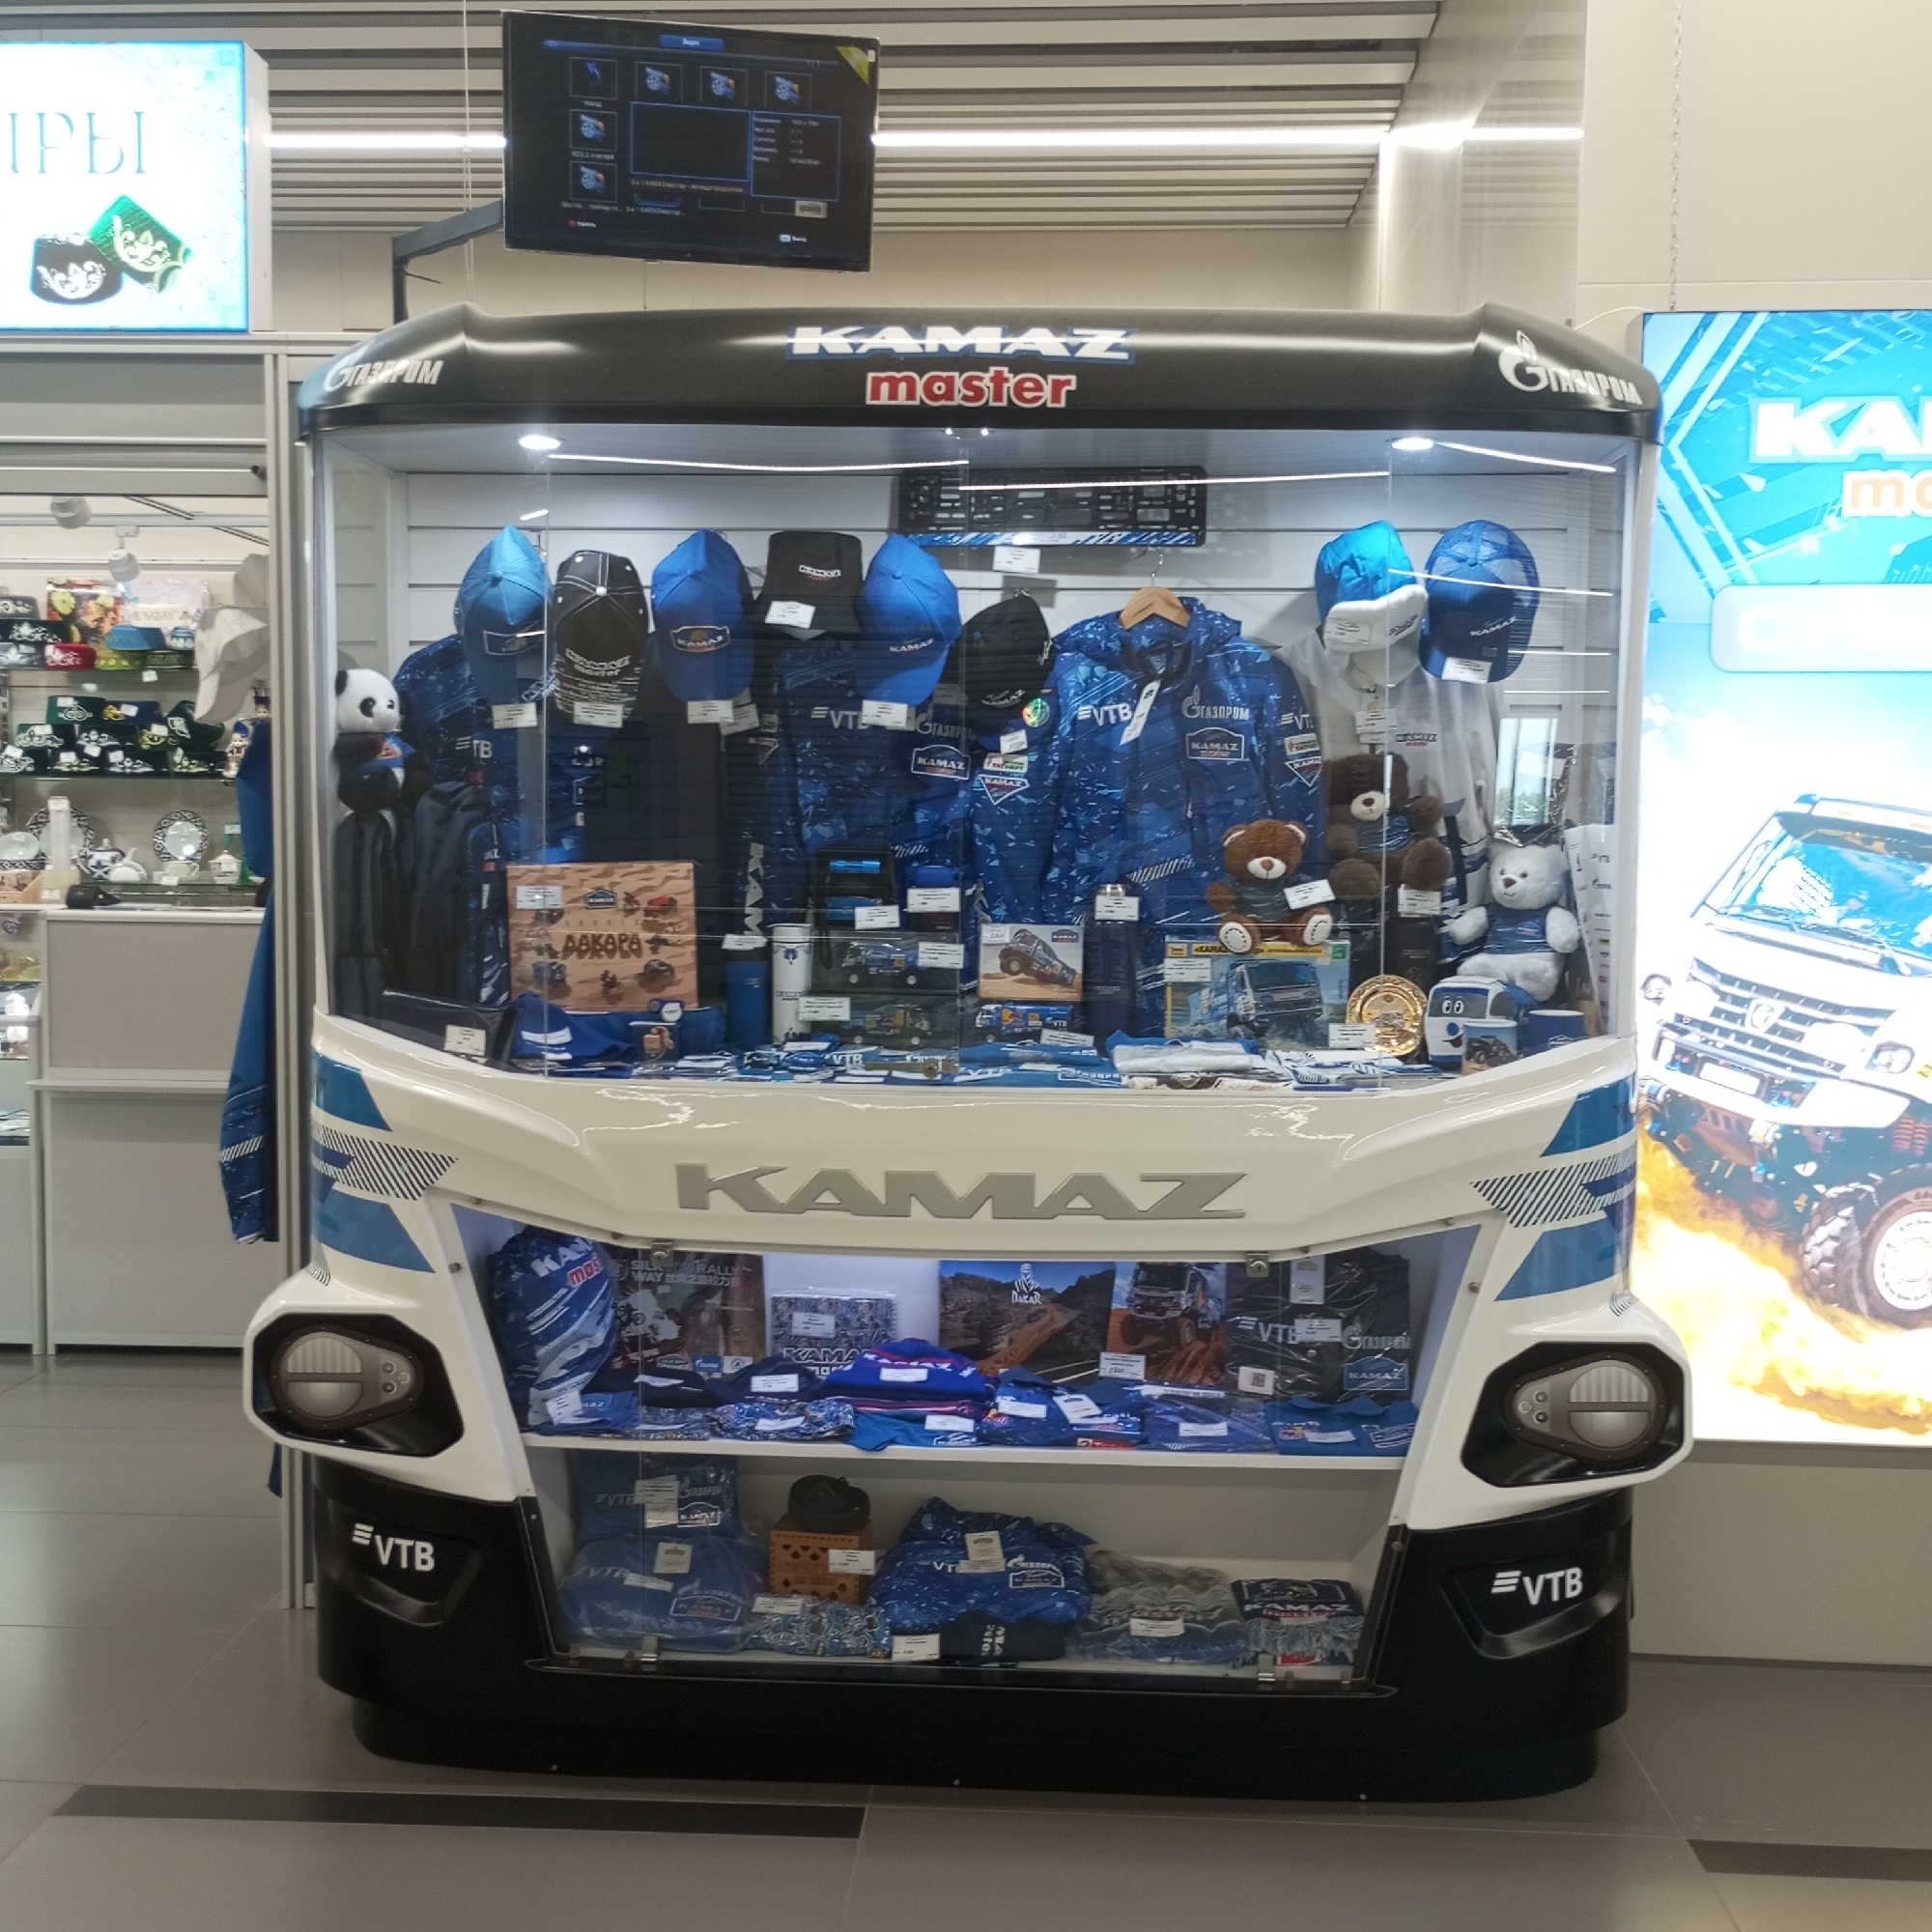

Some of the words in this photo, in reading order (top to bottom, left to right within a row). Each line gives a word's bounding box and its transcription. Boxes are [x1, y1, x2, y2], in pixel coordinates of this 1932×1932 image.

[789, 326, 1132, 361] KAMAZ
[346, 359, 444, 385] ГАЗПРОМ
[867, 367, 1076, 407] master
[1548, 368, 1643, 405] ГАЗПРОМ
[1750, 396, 1932, 463] KA
[799, 564, 841, 578] KAMAZ
[1469, 615, 1518, 637] KAMAZ
[677, 636, 723, 647] KAMAZ
[890, 638, 934, 652] KAMAZ
[1093, 702, 1133, 725] VTB
[1200, 705, 1249, 721] ГАЗПРОМ
[1191, 741, 1238, 752] KAMAZ
[917, 756, 966, 770] KAMAZ
[985, 777, 1022, 787] KAMAZ
[833, 1053, 864, 1065] VTB
[676, 1162, 1249, 1220] KAMAZ
[631, 1260, 665, 1272] SIL
[631, 1271, 665, 1283] WAY
[1011, 1291, 1042, 1305] DAKAR
[782, 1347, 857, 1363] KAMA
[1349, 1372, 1403, 1381] KAMAZ
[375, 1534, 435, 1572] VTB
[933, 1561, 957, 1574] VT
[1522, 1566, 1583, 1605] VTB
[1243, 1603, 1352, 1612] KAMAZ
